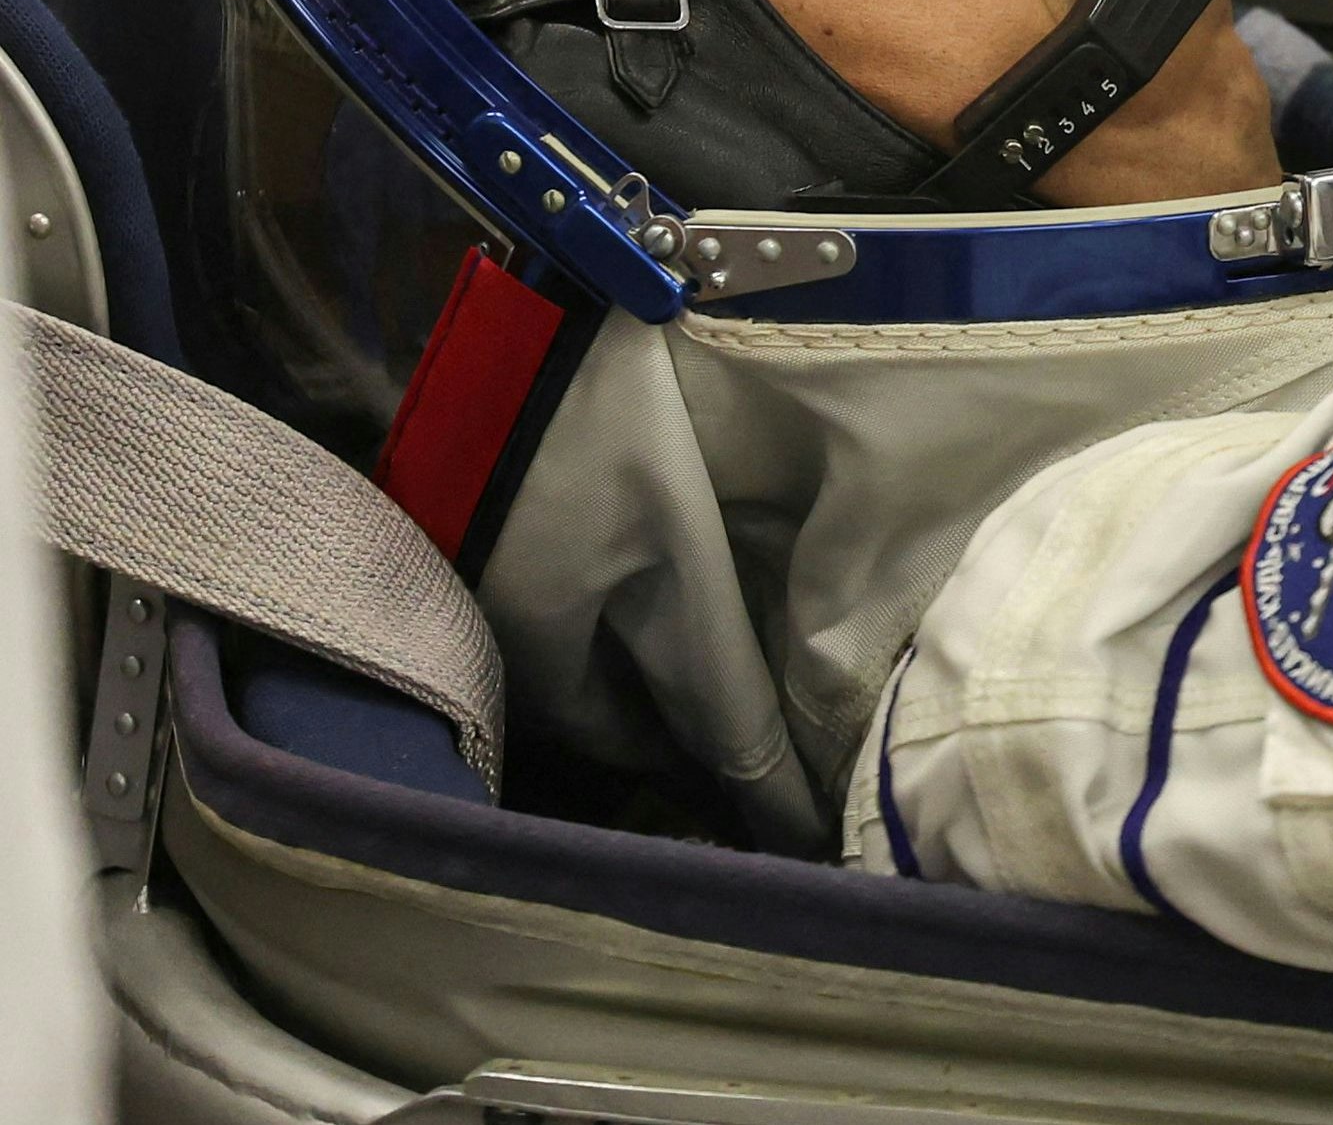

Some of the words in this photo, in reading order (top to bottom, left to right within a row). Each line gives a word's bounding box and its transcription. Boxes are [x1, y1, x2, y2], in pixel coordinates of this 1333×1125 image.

[1038, 136, 1055, 155] 2
[1058, 116, 1076, 134] 3
[1081, 101, 1096, 116] 4
[1101, 78, 1118, 98] 5
